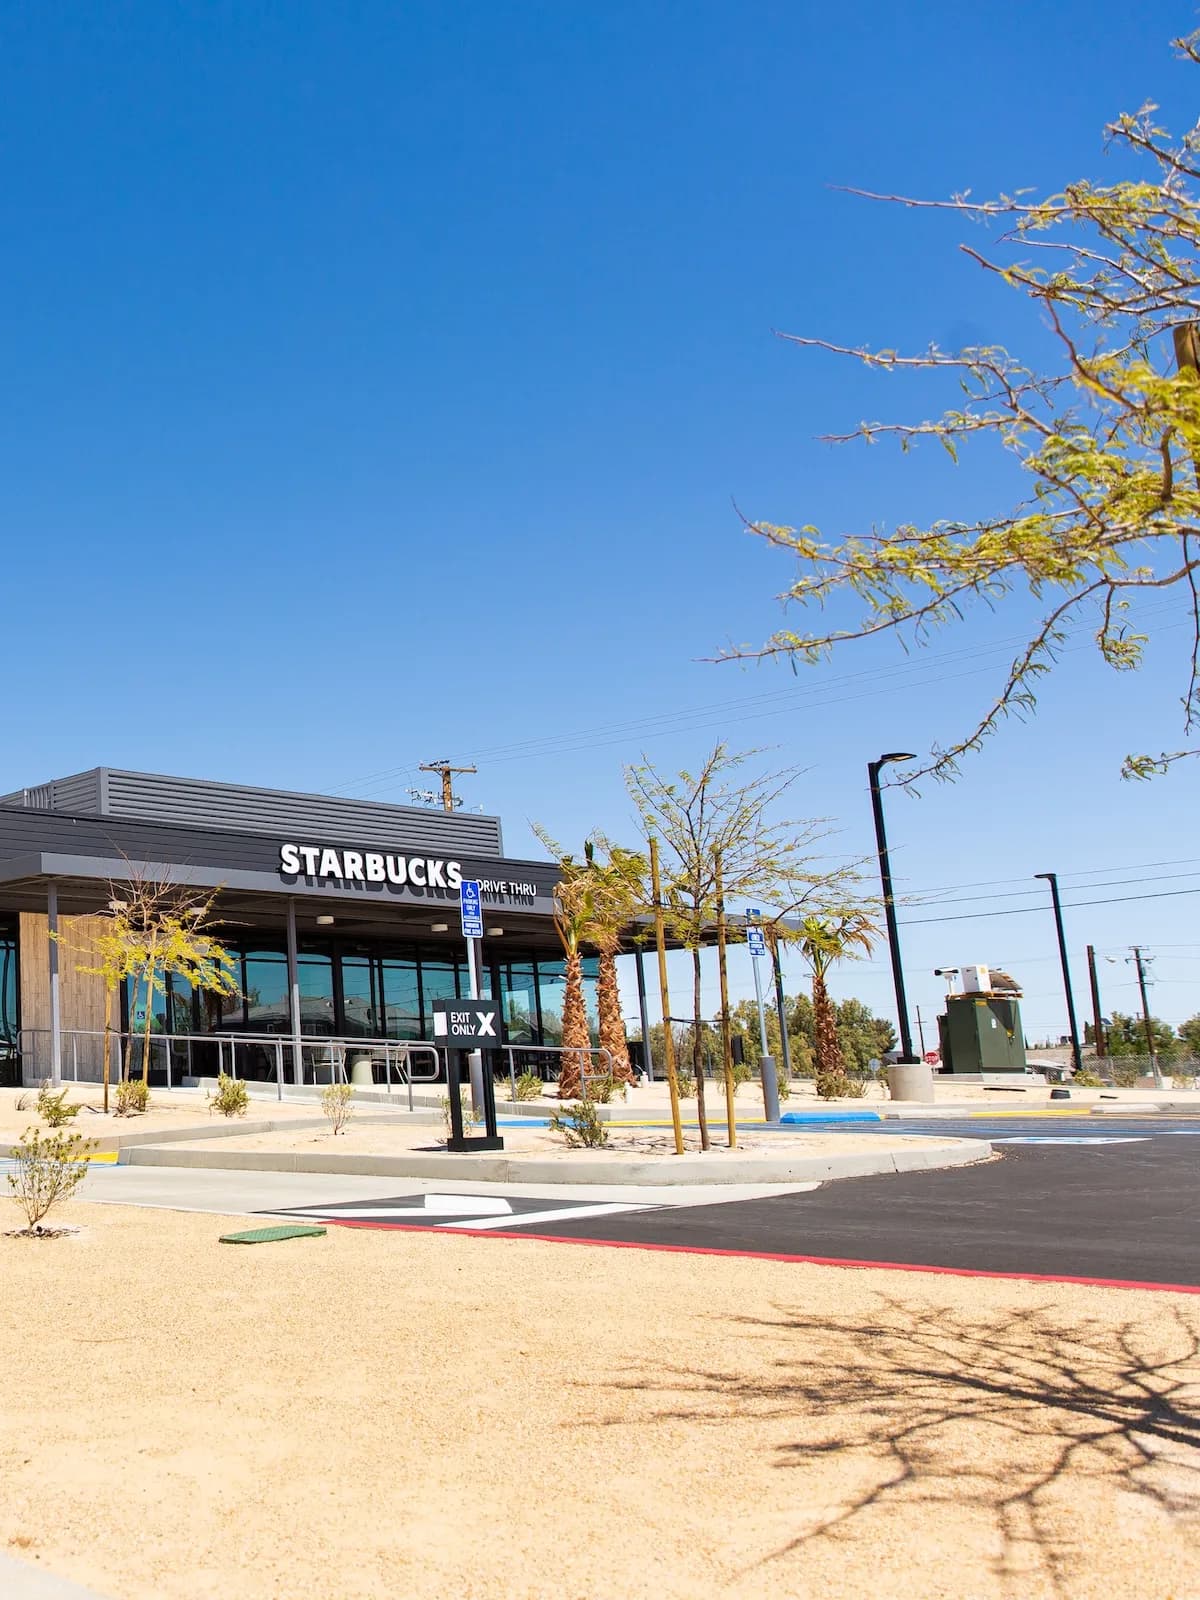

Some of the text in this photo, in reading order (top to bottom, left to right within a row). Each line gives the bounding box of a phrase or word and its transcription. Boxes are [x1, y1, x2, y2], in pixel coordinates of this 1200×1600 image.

[280, 844, 463, 890] STARBUCKS
[476, 879, 537, 897] DRIVE THRU
[451, 1012, 470, 1023] EXIT
[451, 1024, 476, 1036] ONLY
